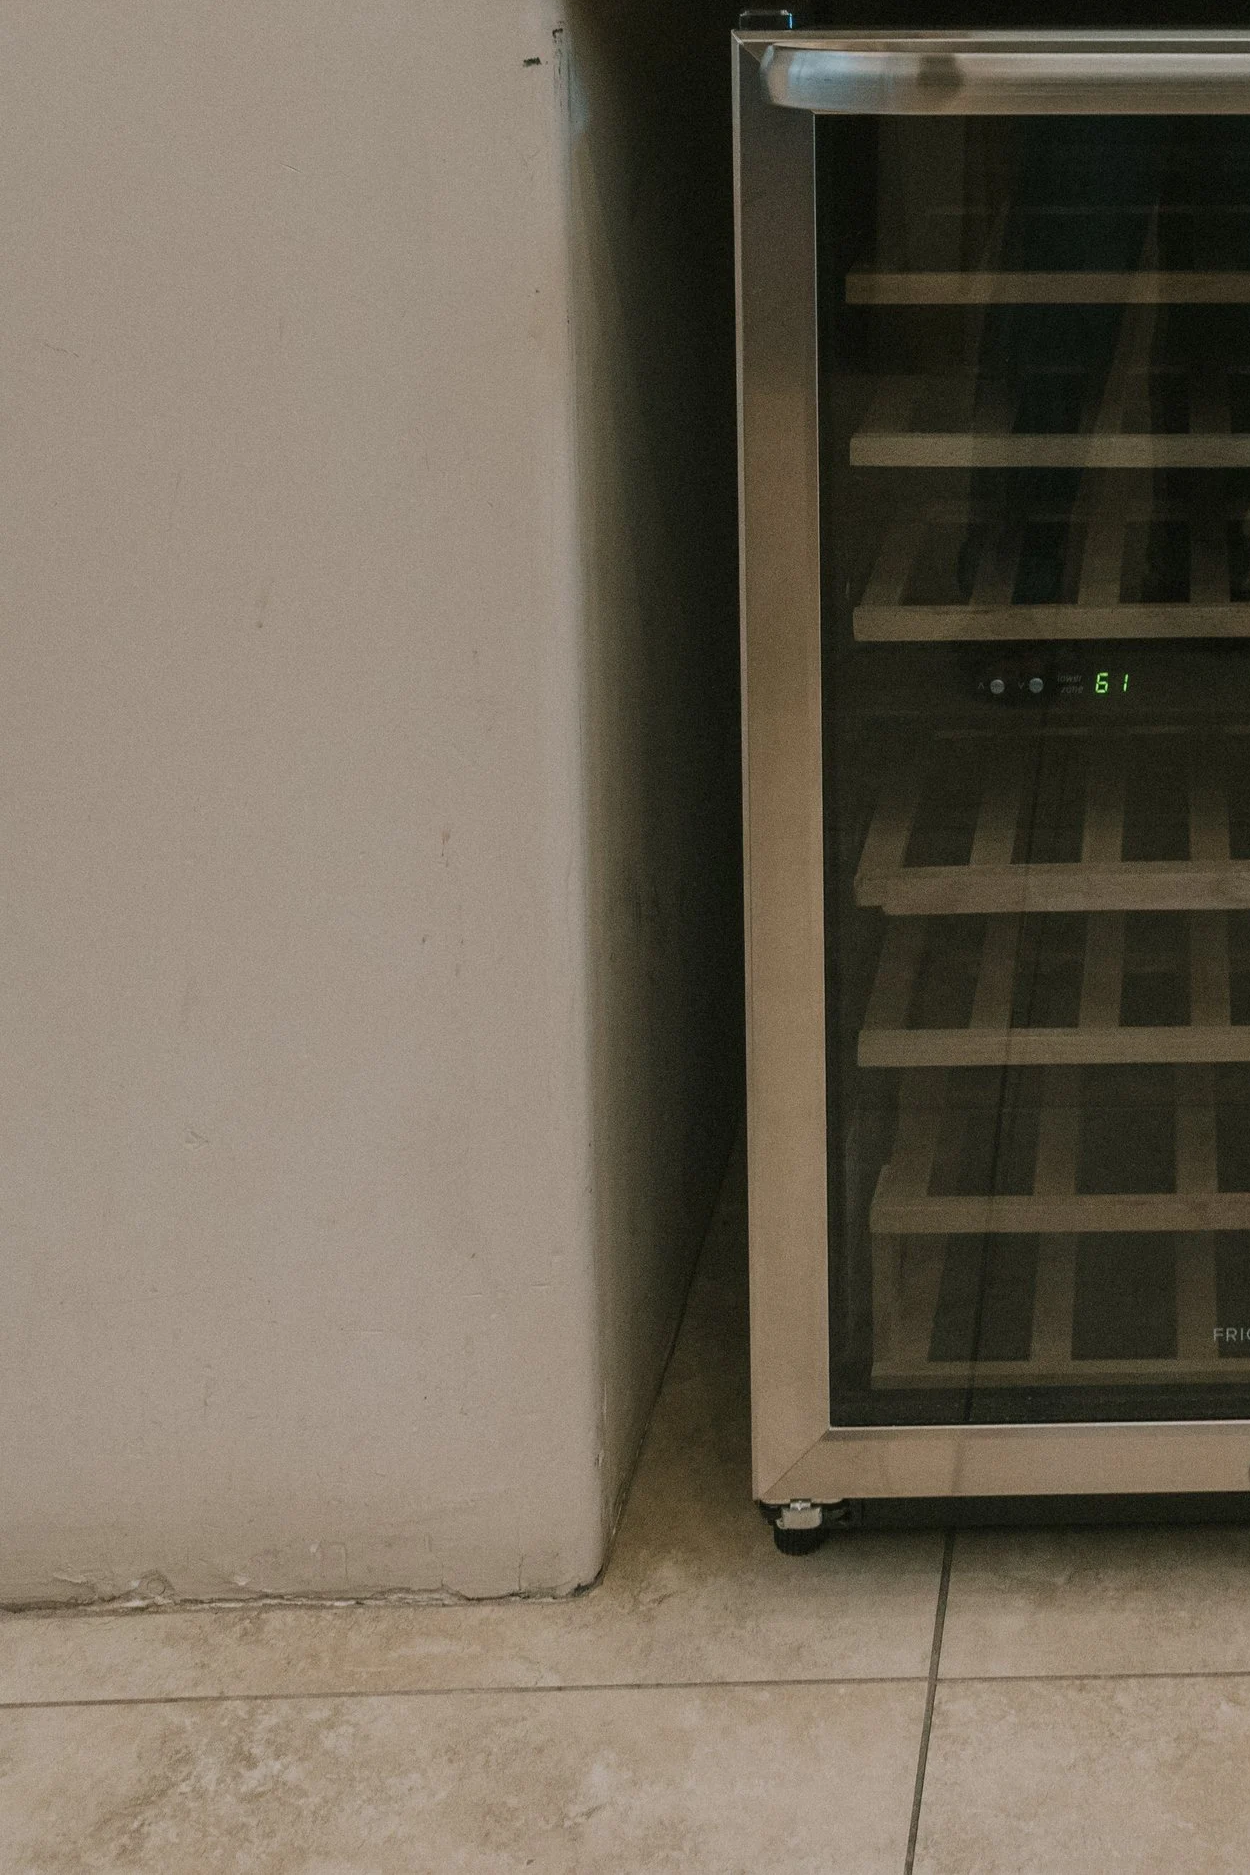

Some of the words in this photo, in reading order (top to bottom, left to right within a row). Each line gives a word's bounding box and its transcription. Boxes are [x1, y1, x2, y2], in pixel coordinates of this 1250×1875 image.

[1057, 673, 1082, 682] lower
[1095, 672, 1129, 694] 61
[1060, 685, 1084, 694] zone
